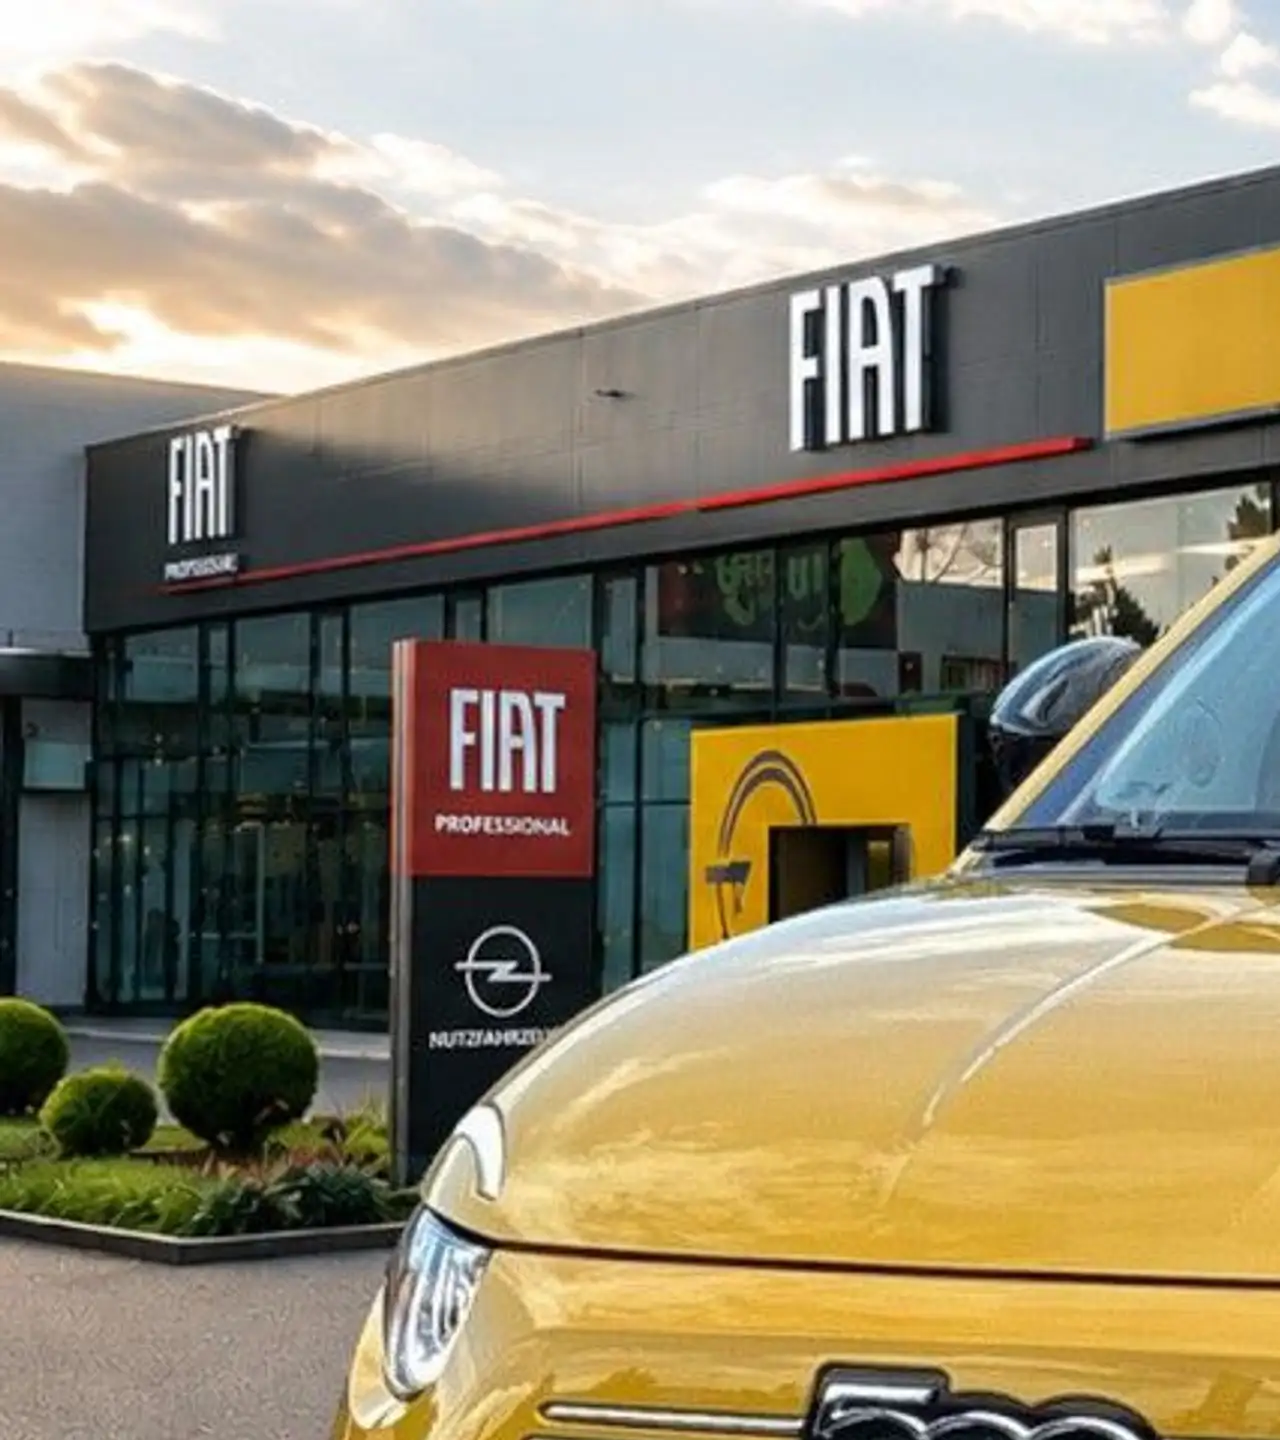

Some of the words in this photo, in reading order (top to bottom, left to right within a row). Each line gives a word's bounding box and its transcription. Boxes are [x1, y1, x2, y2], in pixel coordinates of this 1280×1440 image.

[790, 263, 935, 453] FIAT
[168, 425, 232, 544] FIAT
[450, 687, 567, 793] FIAT
[434, 813, 570, 836] PROFESSIONAL
